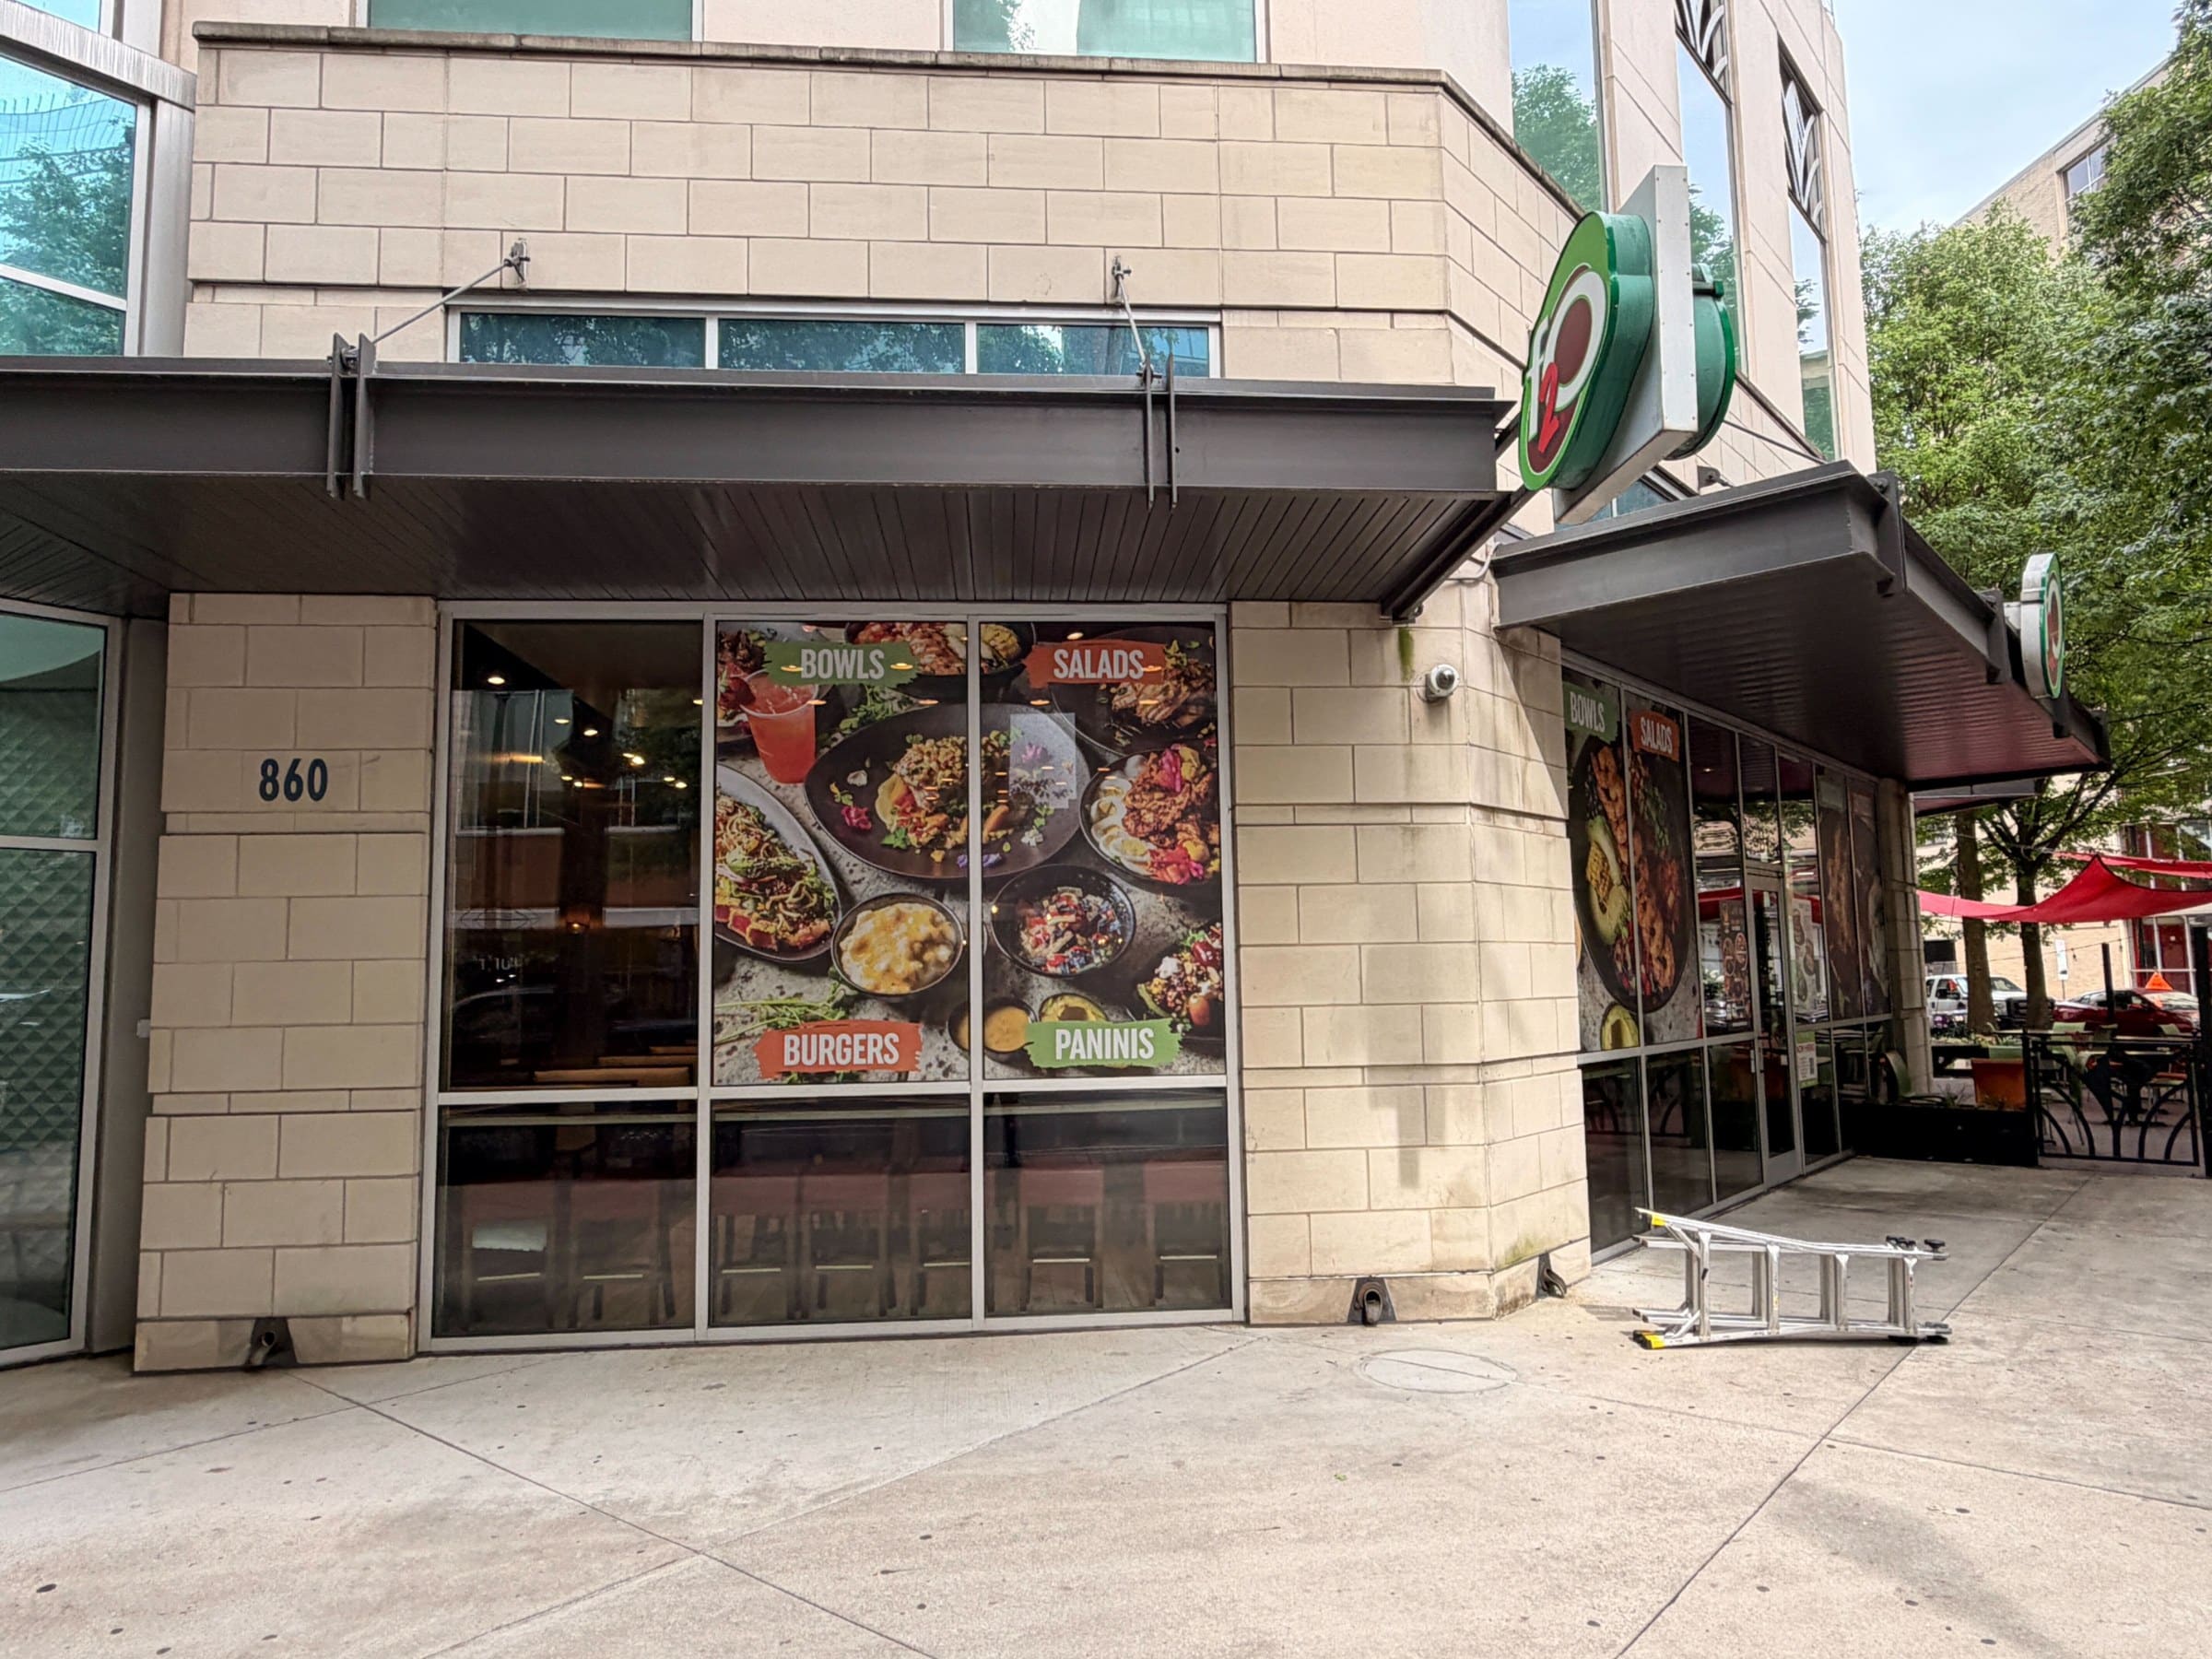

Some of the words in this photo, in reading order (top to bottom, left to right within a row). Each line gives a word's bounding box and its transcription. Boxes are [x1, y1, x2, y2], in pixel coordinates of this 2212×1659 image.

[801, 648, 885, 679] BOWLS
[1053, 648, 1144, 679] SALADS
[1570, 691, 1606, 733] BOWLS
[1641, 716, 1673, 755] SALADS
[259, 758, 328, 802] 860
[783, 1032, 900, 1066] BURGERS
[1055, 1028, 1155, 1060] PANINIS
